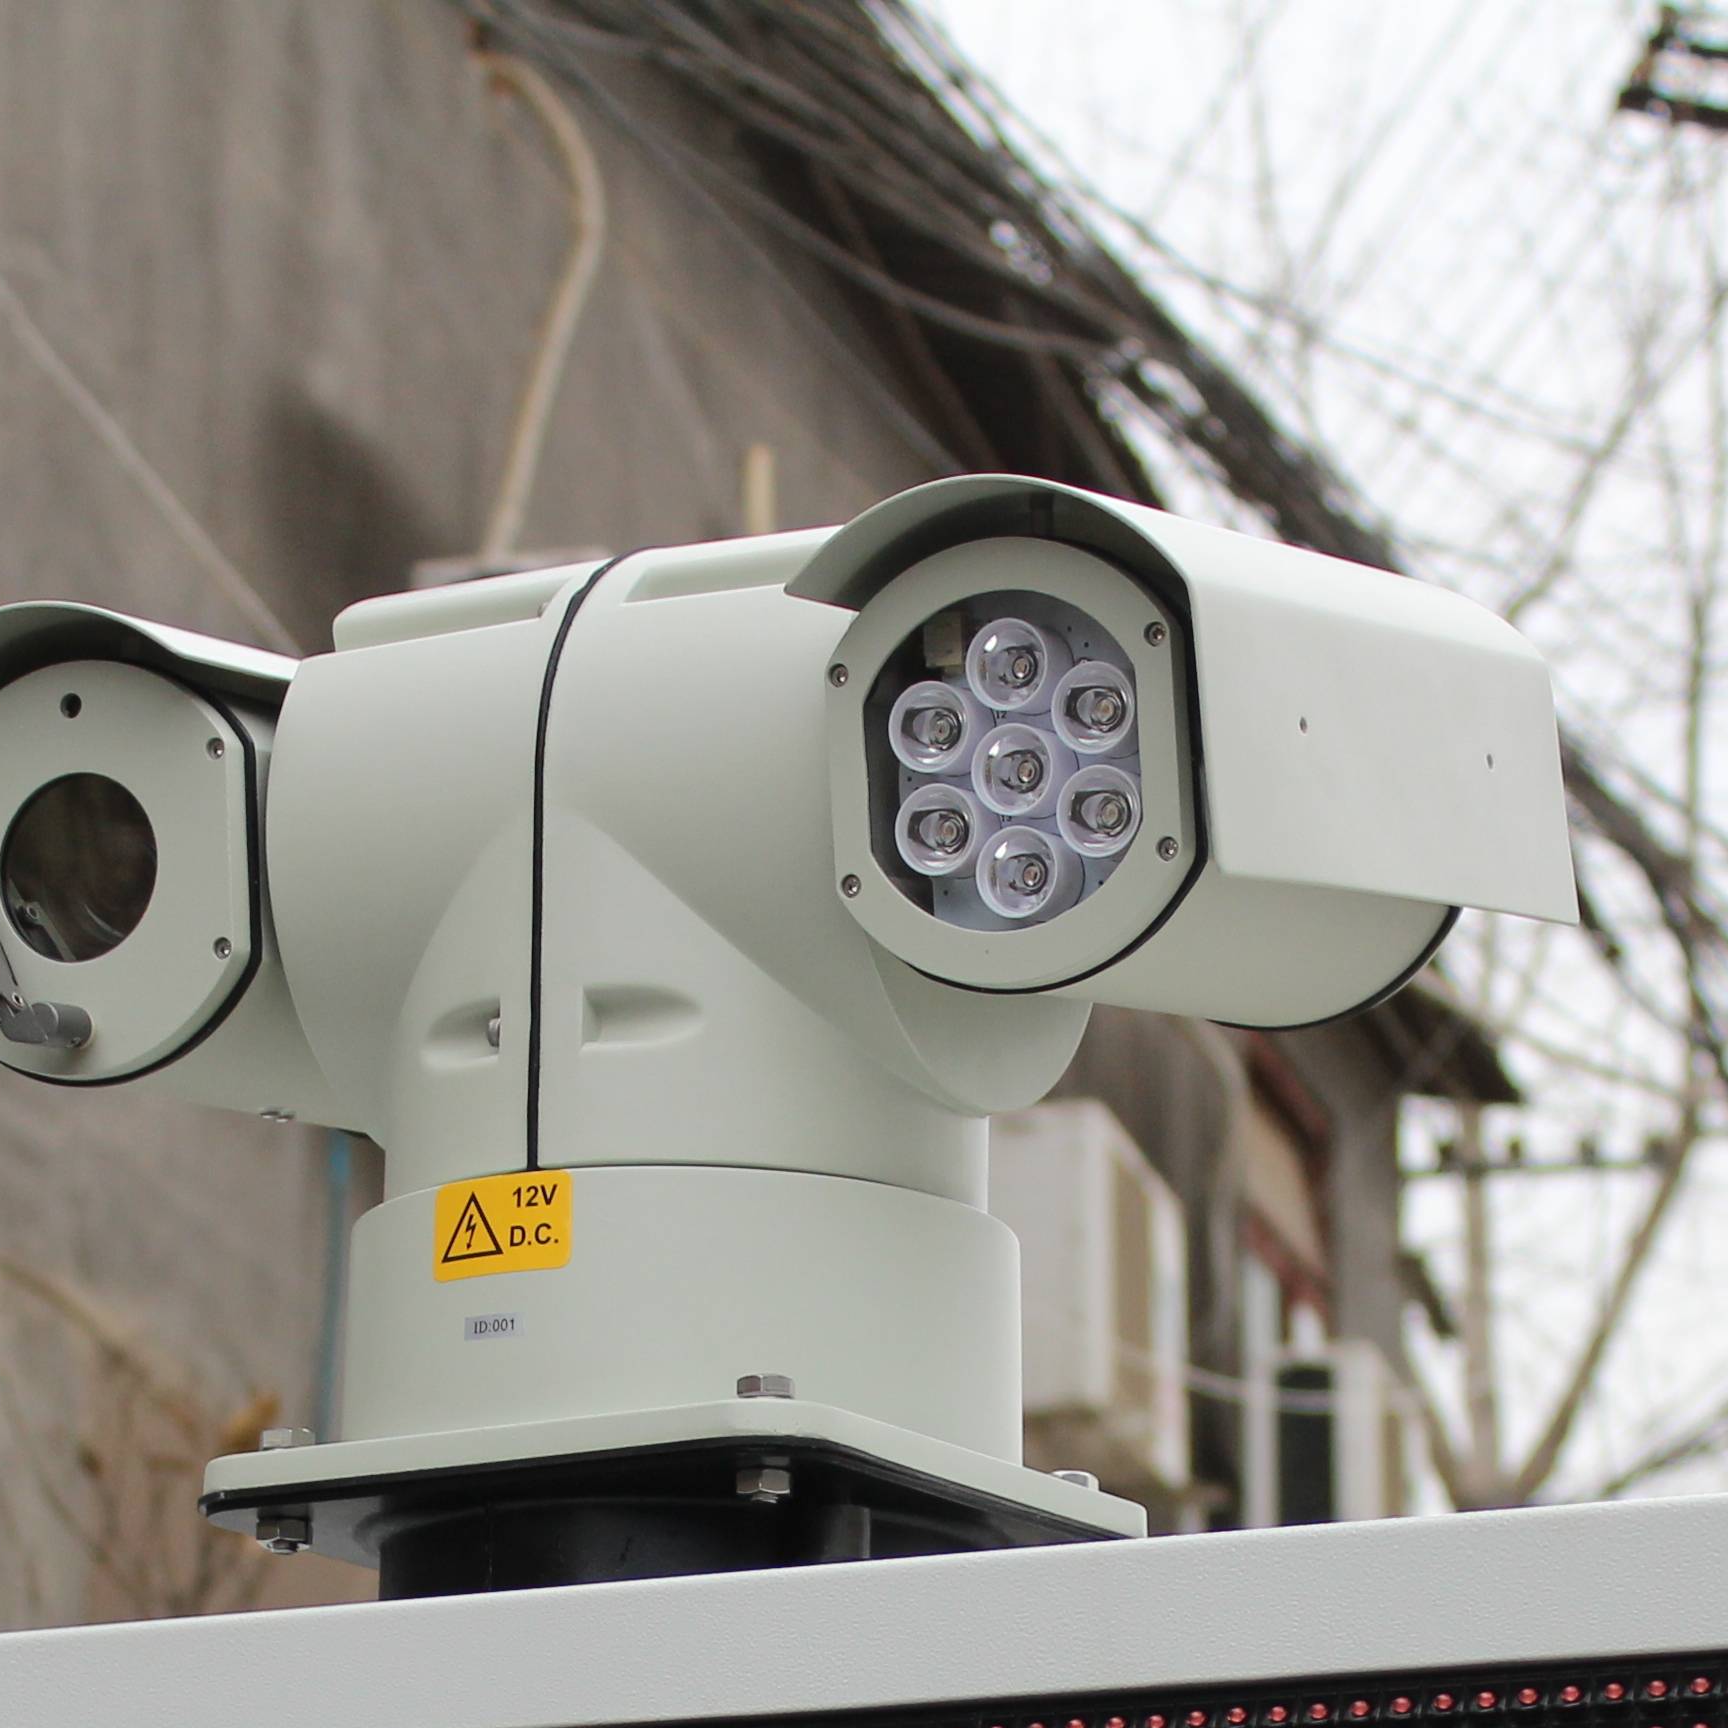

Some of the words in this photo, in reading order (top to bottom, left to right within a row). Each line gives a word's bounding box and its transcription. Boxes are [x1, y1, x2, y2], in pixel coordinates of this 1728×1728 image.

[512, 1183, 559, 1208] 12V
[509, 1222, 560, 1248] D.C.
[473, 1317, 516, 1335] ID:001
